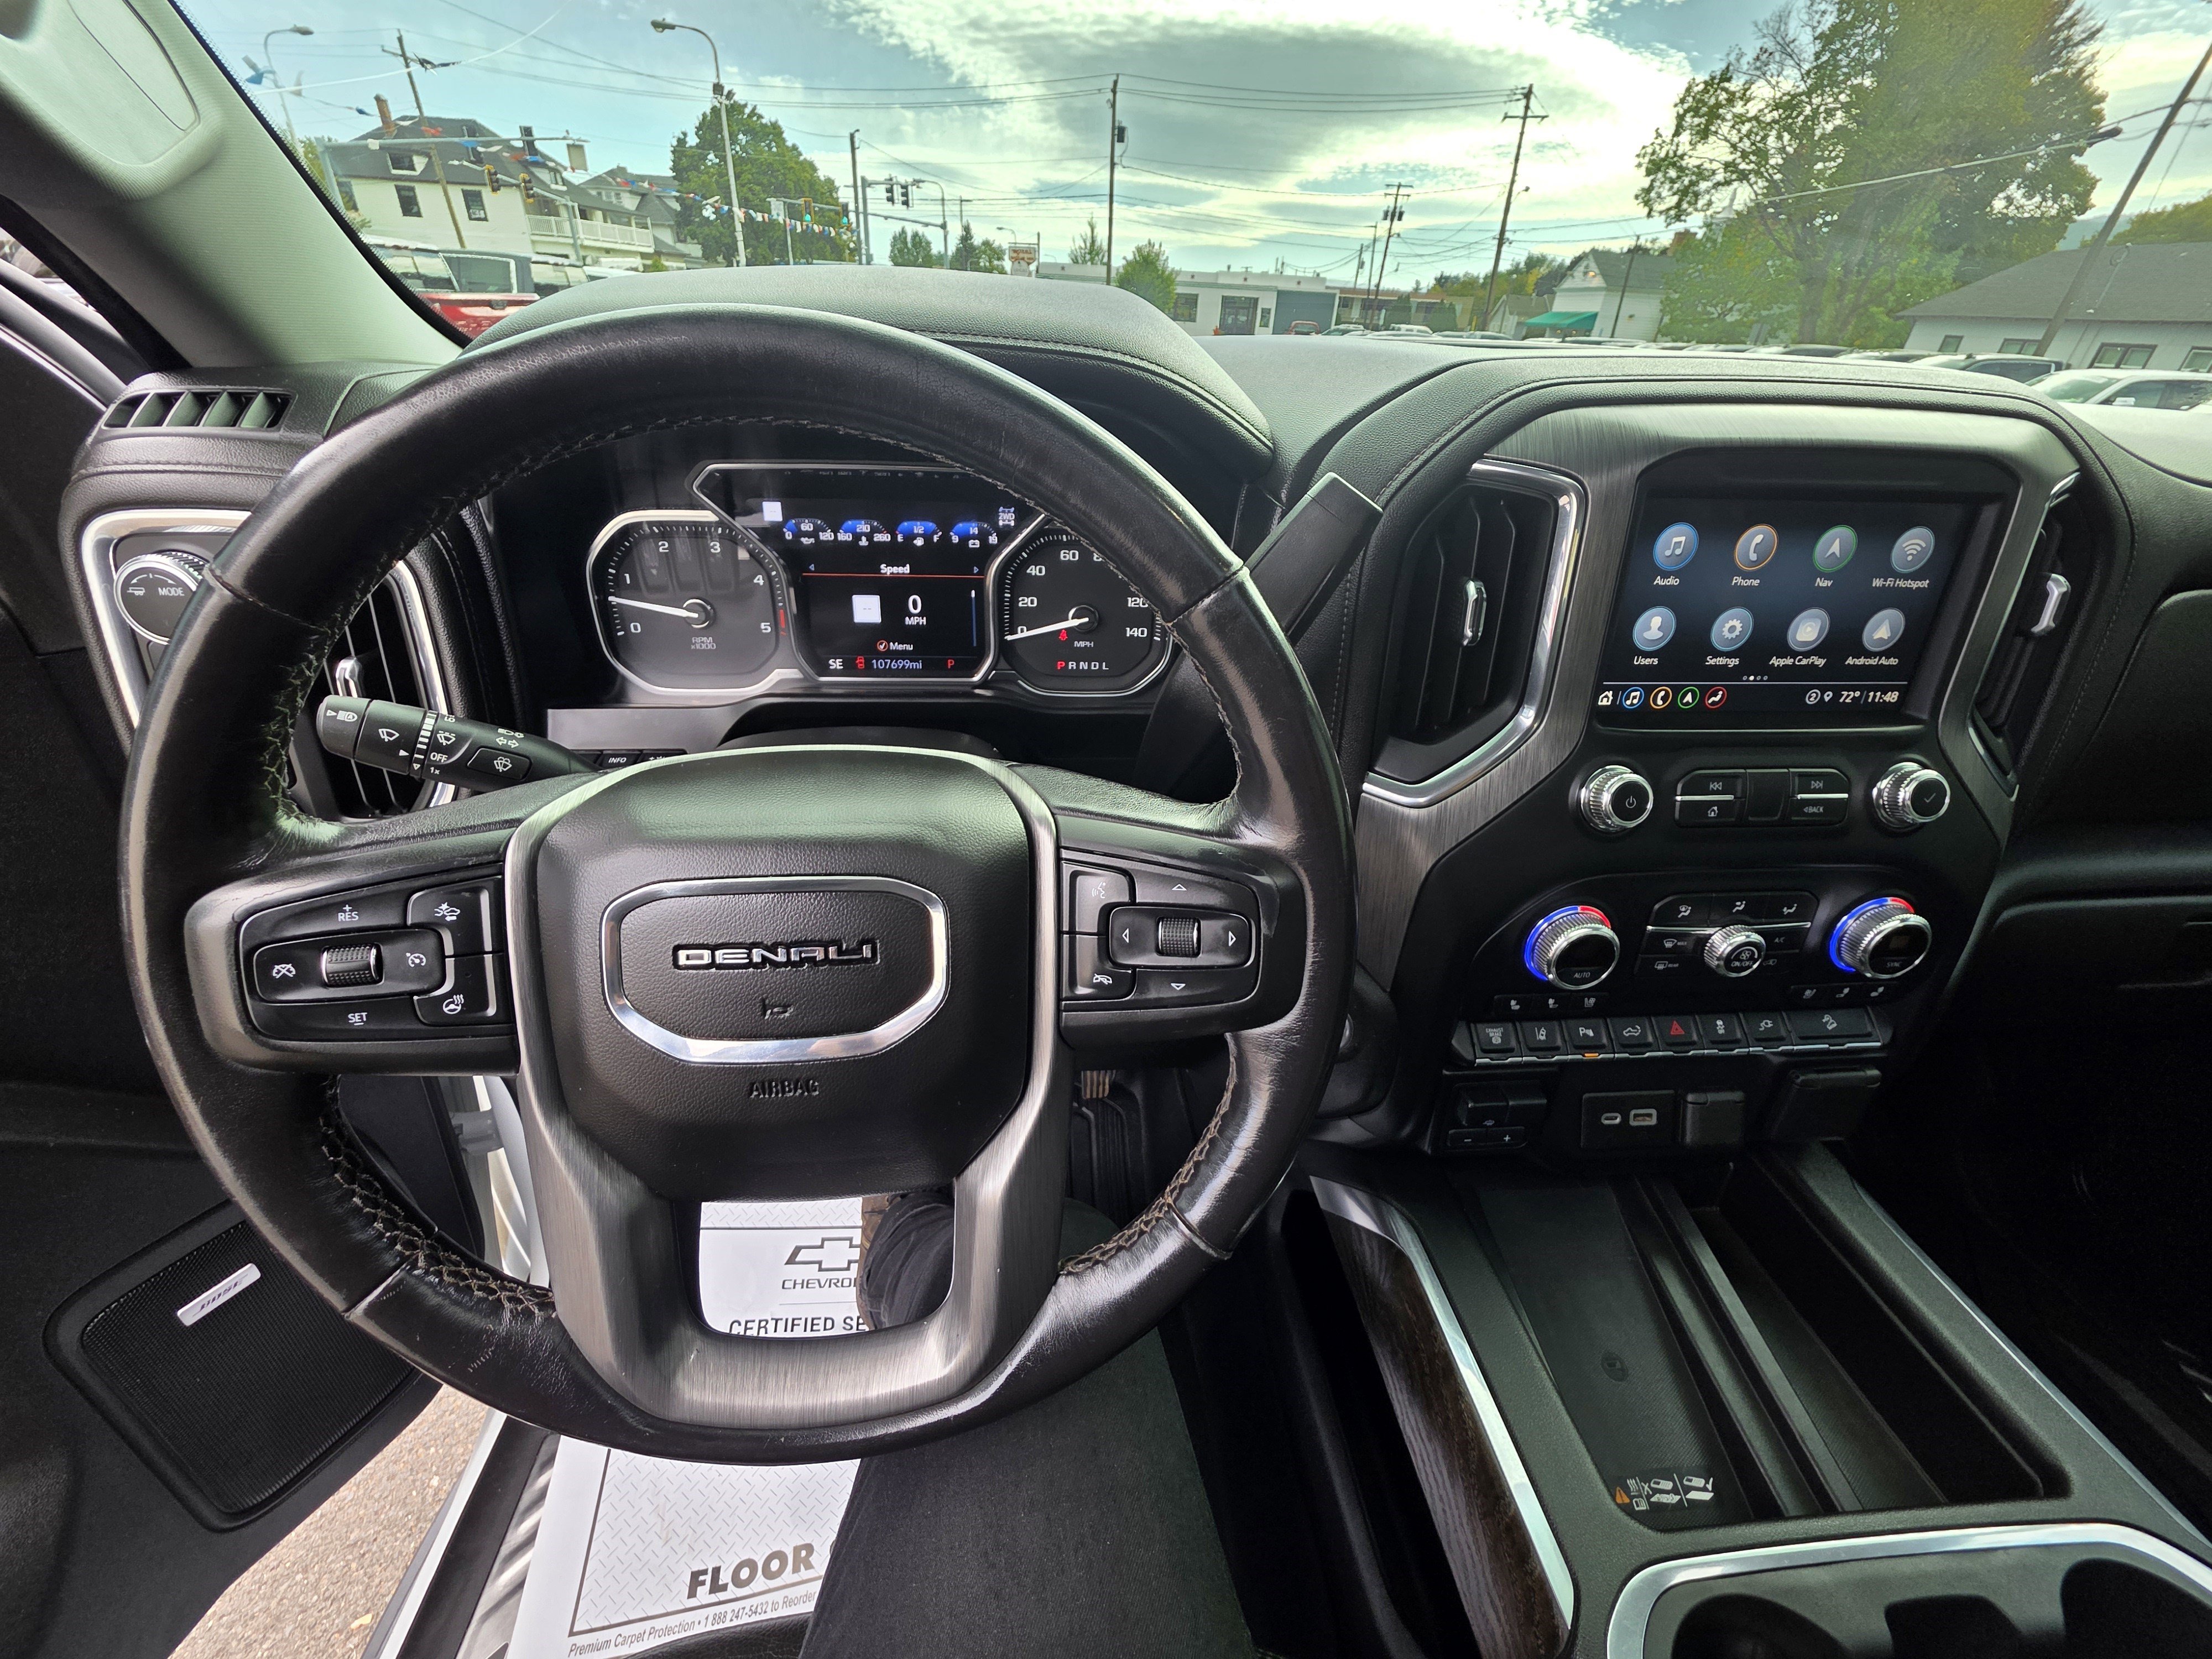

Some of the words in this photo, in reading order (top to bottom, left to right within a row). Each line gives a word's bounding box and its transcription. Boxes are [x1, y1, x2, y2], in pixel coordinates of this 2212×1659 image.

[785, 531, 792, 540] 0
[818, 532, 834, 540] 120
[837, 533, 852, 541] 160
[933, 535, 940, 543] F
[988, 536, 998, 544] 19
[658, 541, 669, 552] 2
[710, 541, 721, 553] 3
[1060, 550, 1079, 561] 60
[880, 564, 910, 576] Speed
[1026, 565, 1046, 576] 40
[624, 573, 630, 585] 1
[754, 575, 764, 586] 4
[1653, 576, 1679, 586] Audio
[1731, 576, 1760, 586] Phone
[1815, 577, 1833, 587] Nav
[1872, 578, 1893, 587] Wi-Fi
[1895, 578, 1929, 589] Hotspot
[158, 587, 185, 596] MODE
[907, 595, 922, 614] 0
[1018, 597, 1037, 607] 20
[1127, 597, 1149, 607] 120
[905, 616, 926, 625] MPH
[630, 623, 641, 633] 0
[760, 623, 771, 633] 5
[1125, 627, 1147, 637] 140
[890, 641, 913, 651] Menu
[828, 659, 843, 669] SE
[872, 659, 922, 670] 107699mi
[948, 659, 955, 669] P
[1634, 655, 1658, 665] Users
[1705, 655, 1740, 667] Settings
[1769, 656, 1792, 667] Apple
[1793, 656, 1827, 667] CarPlay
[1845, 656, 1876, 665] Android
[1877, 656, 1898, 665] Auto
[1839, 691, 1860, 702] 72°
[1868, 691, 1899, 702] 11:48
[430, 752, 448, 763] OFF
[338, 911, 359, 921] RES
[676, 943, 873, 966] DENALI
[348, 1013, 367, 1023] SET
[749, 1079, 821, 1099] AIRBAG
[729, 1316, 835, 1337] CERTIFIED
[687, 1543, 815, 1599] FLOOR
[568, 1639, 612, 1657] Premium
[614, 1630, 646, 1648] Carpet
[648, 1619, 695, 1641] Protection
[711, 1611, 728, 1626] 888
[729, 1601, 769, 1623] 247-5432
[771, 1599, 779, 1613] to
[782, 1590, 817, 1609] Reorder
